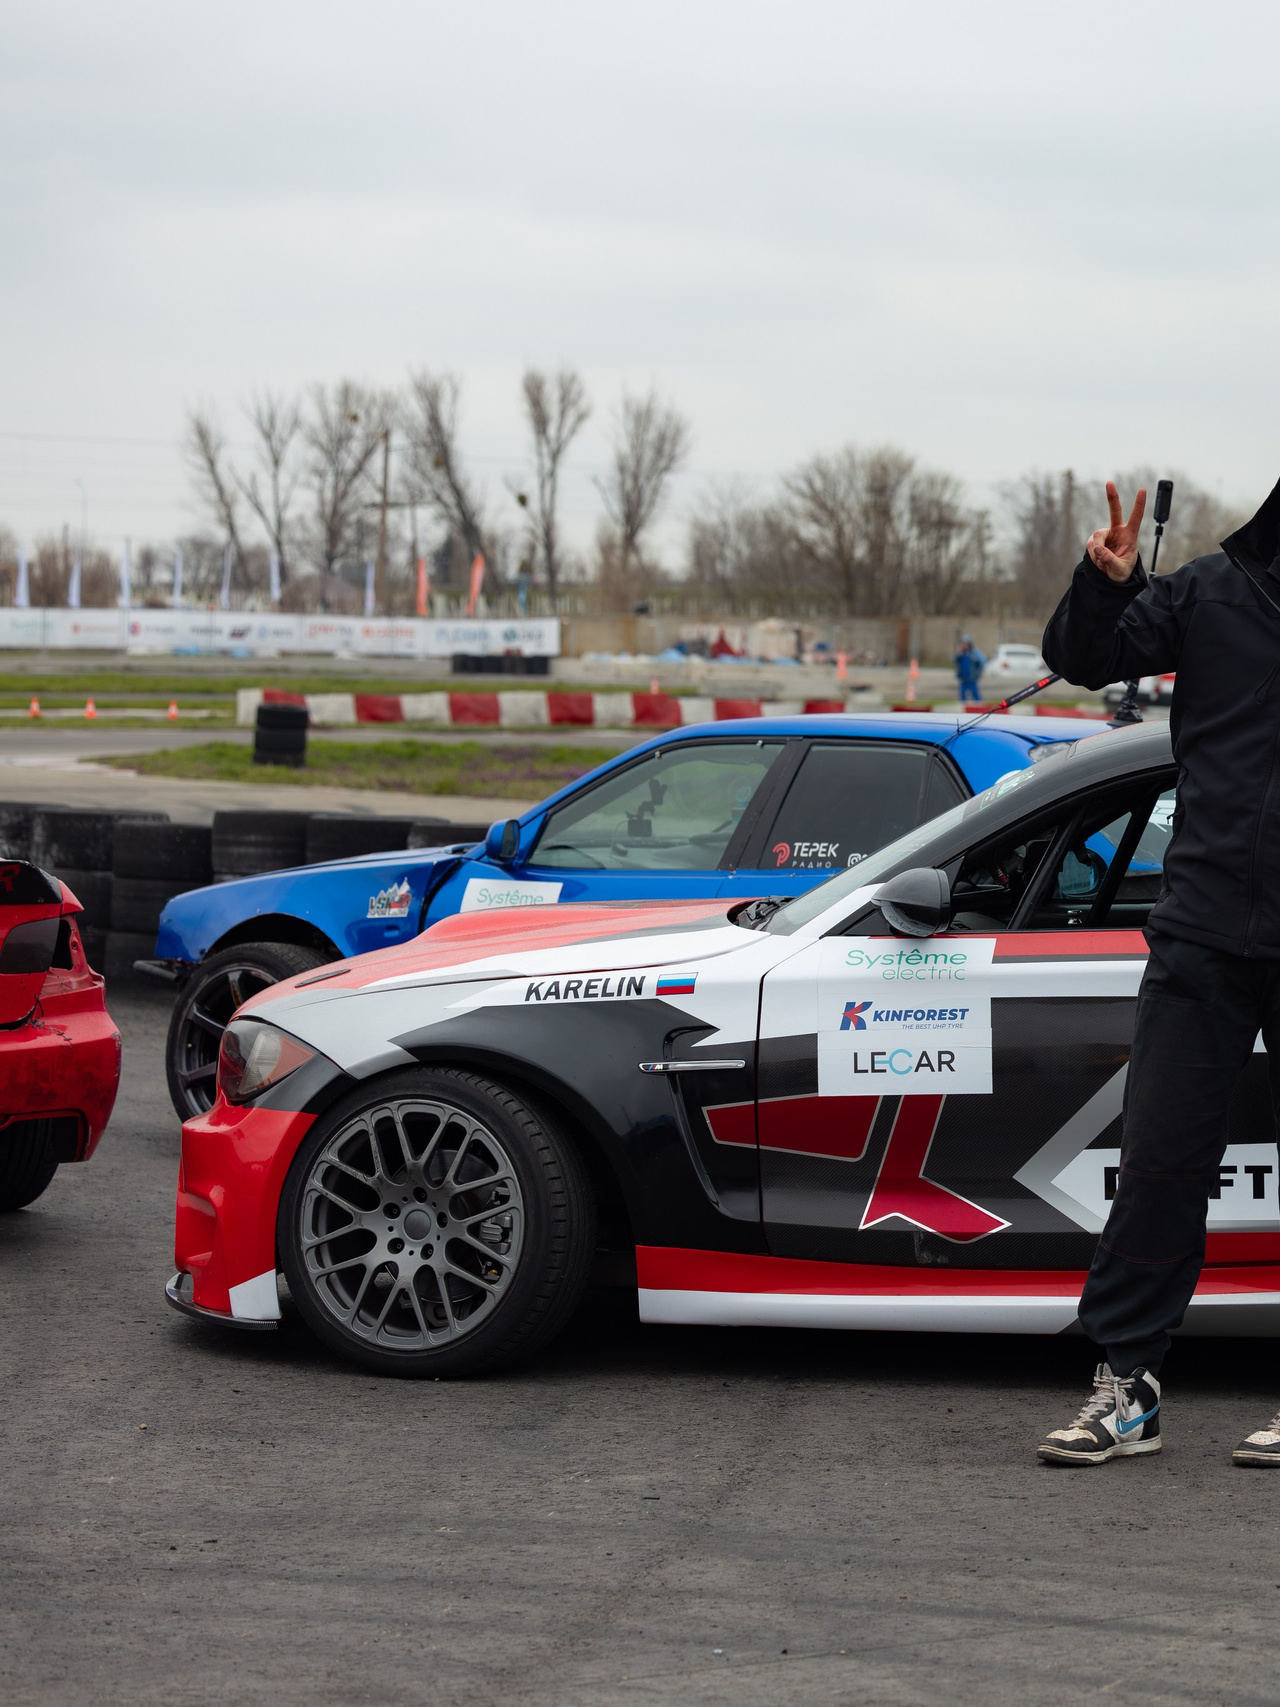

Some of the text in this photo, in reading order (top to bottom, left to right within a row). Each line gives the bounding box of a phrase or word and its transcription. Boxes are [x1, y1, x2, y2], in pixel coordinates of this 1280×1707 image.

[793, 842, 840, 857] ТЕРЕК
[845, 948, 968, 969] Système
[882, 966, 966, 981] electric
[524, 975, 647, 1002] KARELIN
[872, 1008, 970, 1022] KINFOREST
[853, 1048, 956, 1076] LECAR
